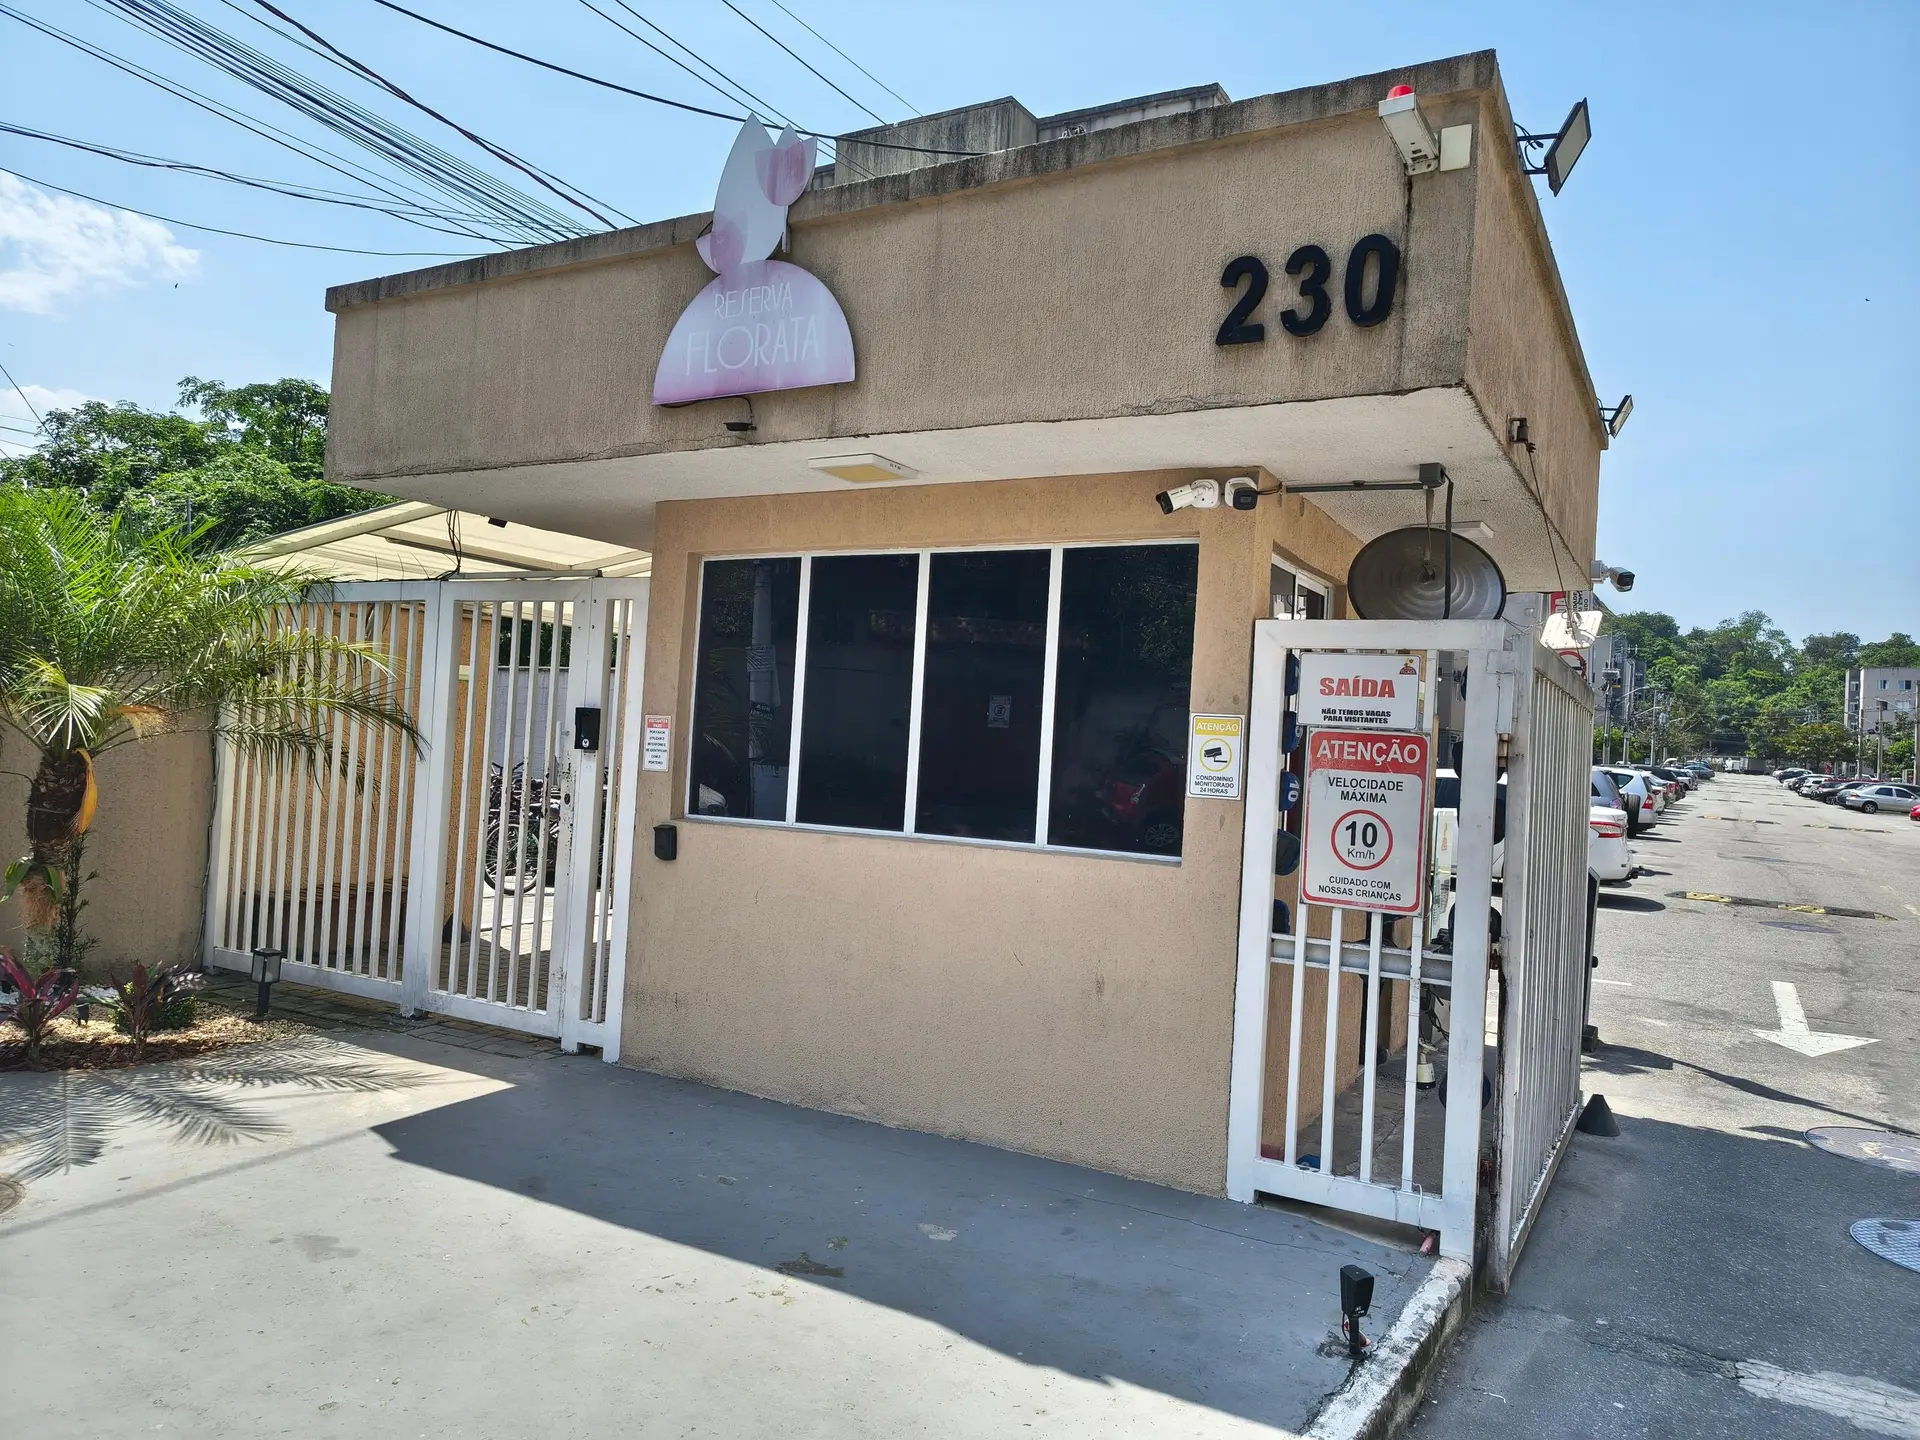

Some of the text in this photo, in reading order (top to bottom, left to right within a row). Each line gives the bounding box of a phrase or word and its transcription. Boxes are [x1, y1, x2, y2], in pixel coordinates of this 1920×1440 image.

[1215, 233, 1400, 346] 230
[714, 282, 793, 320] RESERVA
[685, 314, 820, 377] FLORATA
[1319, 675, 1396, 698] SAÍDA
[1321, 707, 1392, 718] NÃO TEMOS VAGAS
[1344, 716, 1389, 724] VISITANTES
[1195, 721, 1239, 733] ATENÇÃO
[1316, 738, 1421, 766] ATENÇÃO
[1194, 780, 1234, 789] MONITORADO
[1328, 776, 1404, 792] VELOCIDADE
[1340, 788, 1388, 804] MÁXIMA
[1345, 820, 1378, 848] 10
[1347, 848, 1376, 860] Km/h
[1328, 875, 1391, 890] CUIDADO COM
[1318, 884, 1402, 901] NOSSAS CRIANÇAS
